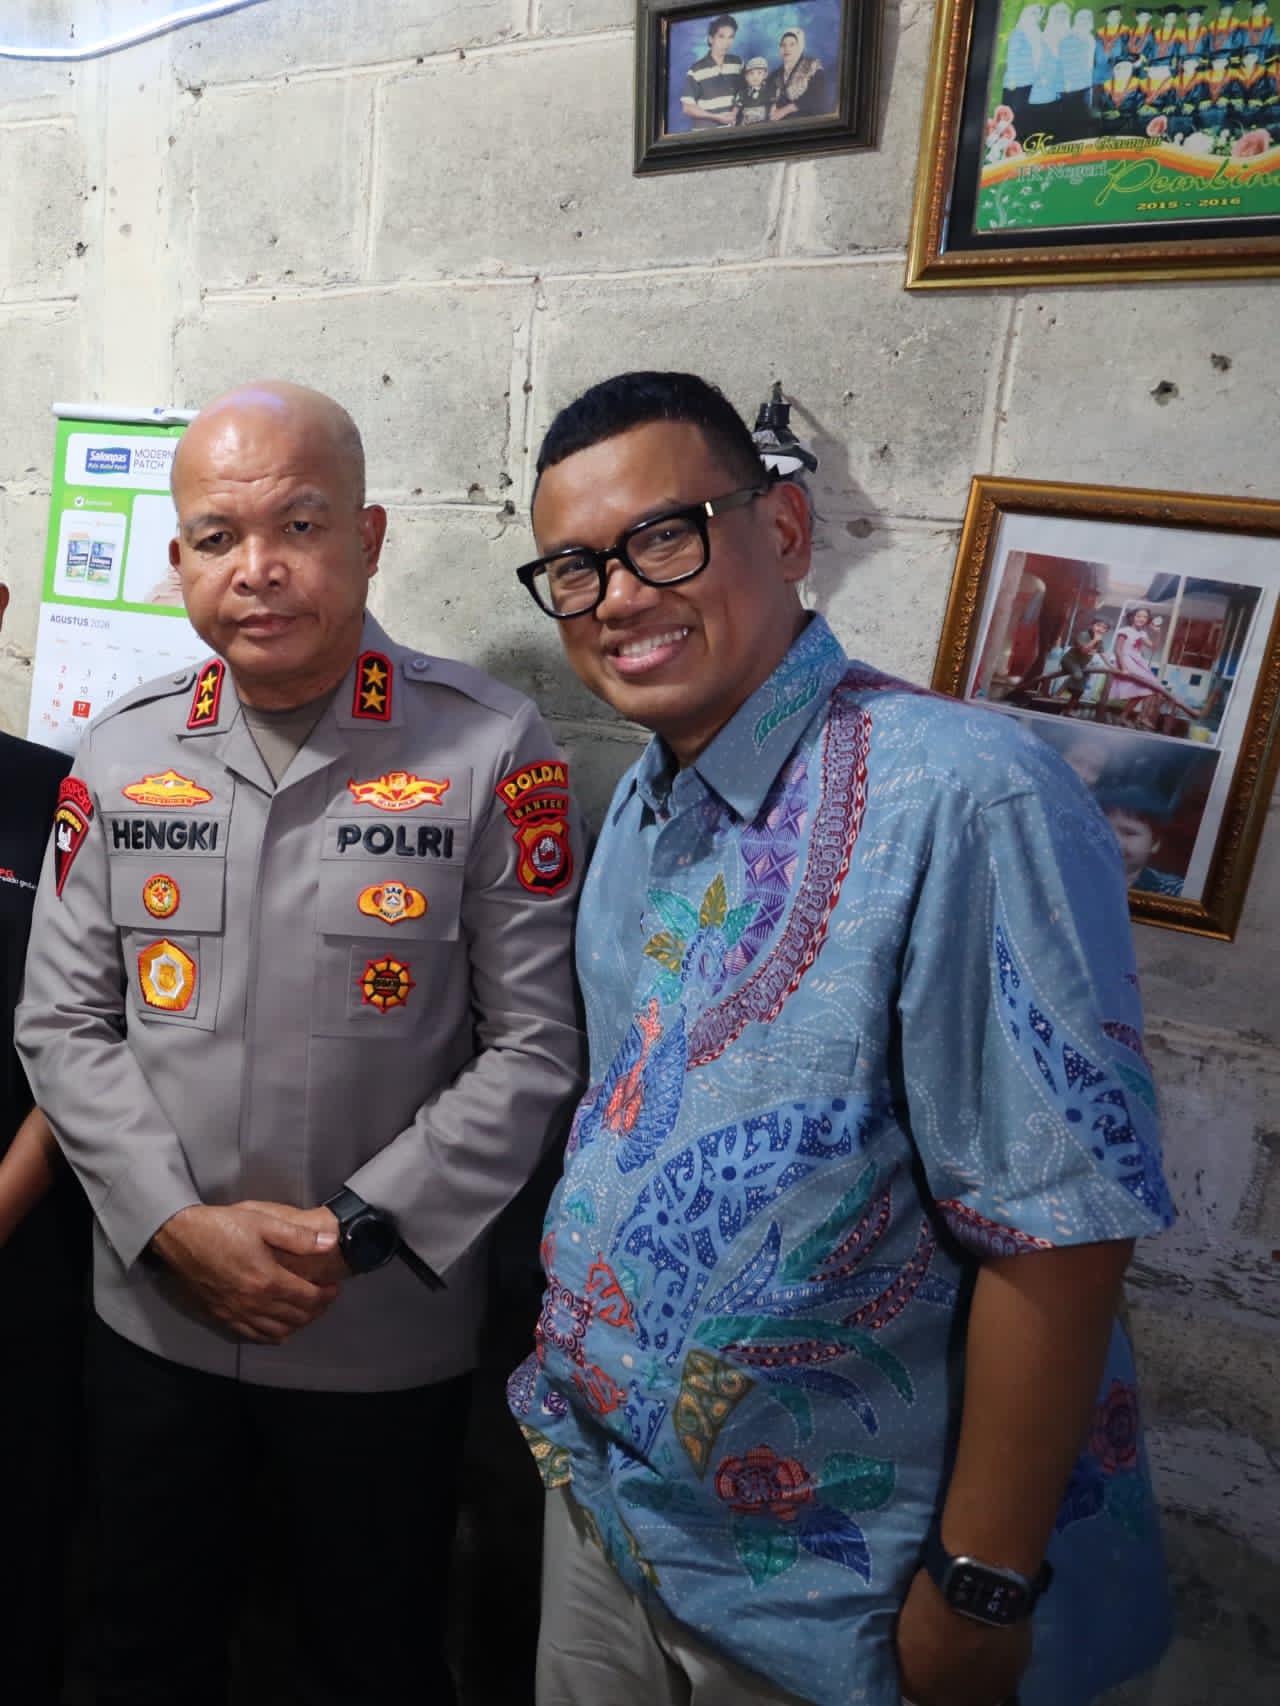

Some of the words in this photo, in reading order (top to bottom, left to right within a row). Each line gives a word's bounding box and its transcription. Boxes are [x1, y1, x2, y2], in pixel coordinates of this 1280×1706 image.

[89, 450, 128, 464] Salonpas
[134, 459, 164, 470] PATCH
[49, 615, 89, 626] AGUSTUS
[503, 765, 565, 801] POLDA
[515, 799, 562, 818] BANTEN
[111, 817, 219, 851] HENGKI
[336, 823, 454, 859] POLRI
